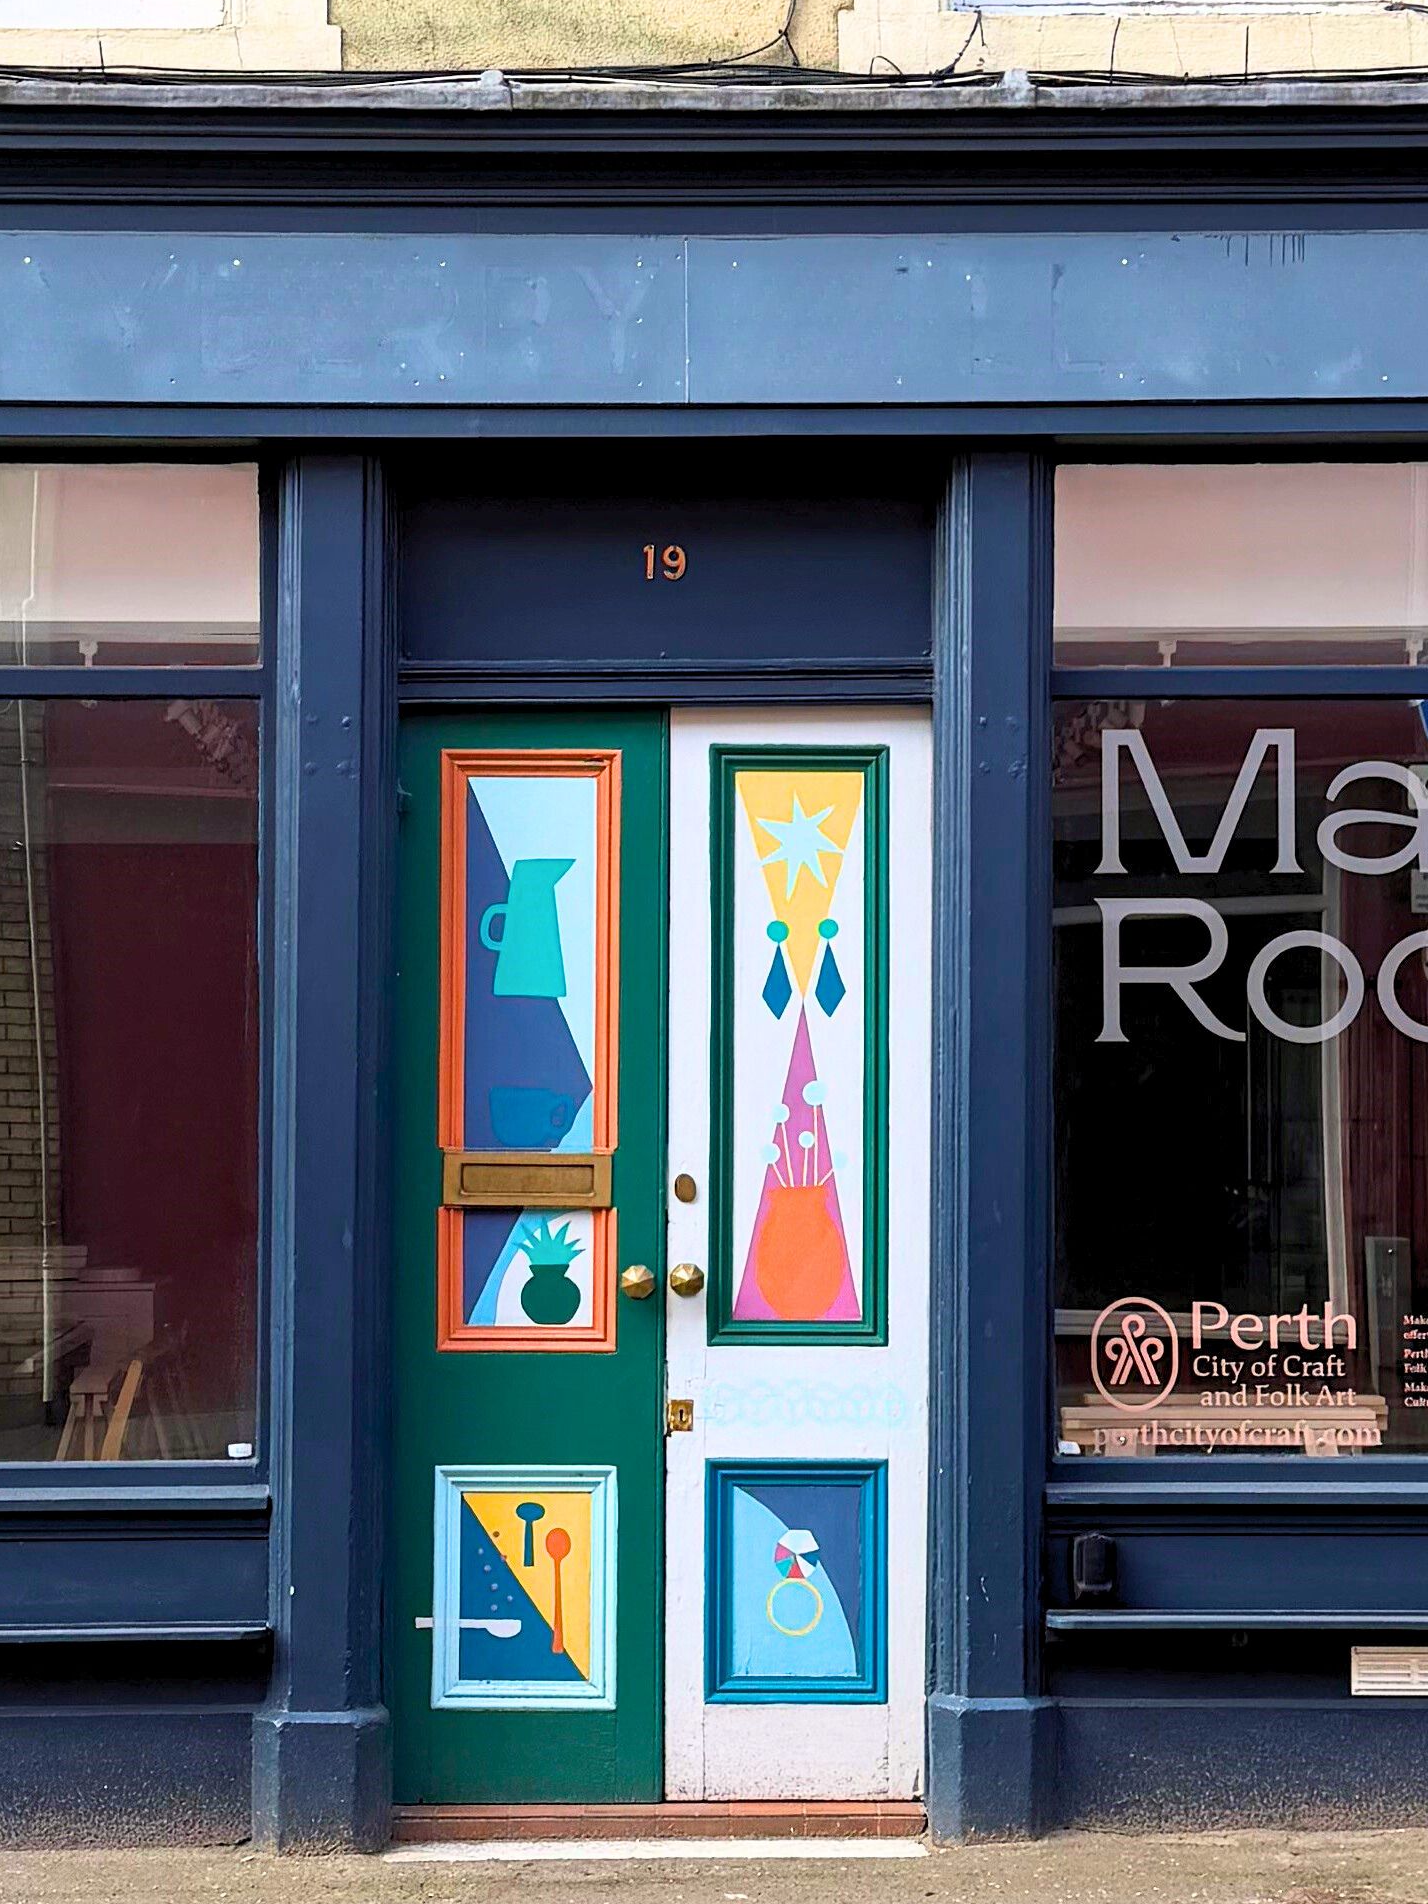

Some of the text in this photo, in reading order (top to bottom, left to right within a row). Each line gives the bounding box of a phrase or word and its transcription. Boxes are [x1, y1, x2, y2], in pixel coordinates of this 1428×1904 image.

[644, 545, 686, 580] 19
[1192, 1301, 1357, 1350] Perth
[1193, 1354, 1346, 1384] City of Craft
[1404, 1362, 1427, 1374] Folk
[1200, 1384, 1357, 1406] and Folk Art
[1094, 1418, 1383, 1452] pthcityofcraftcom
